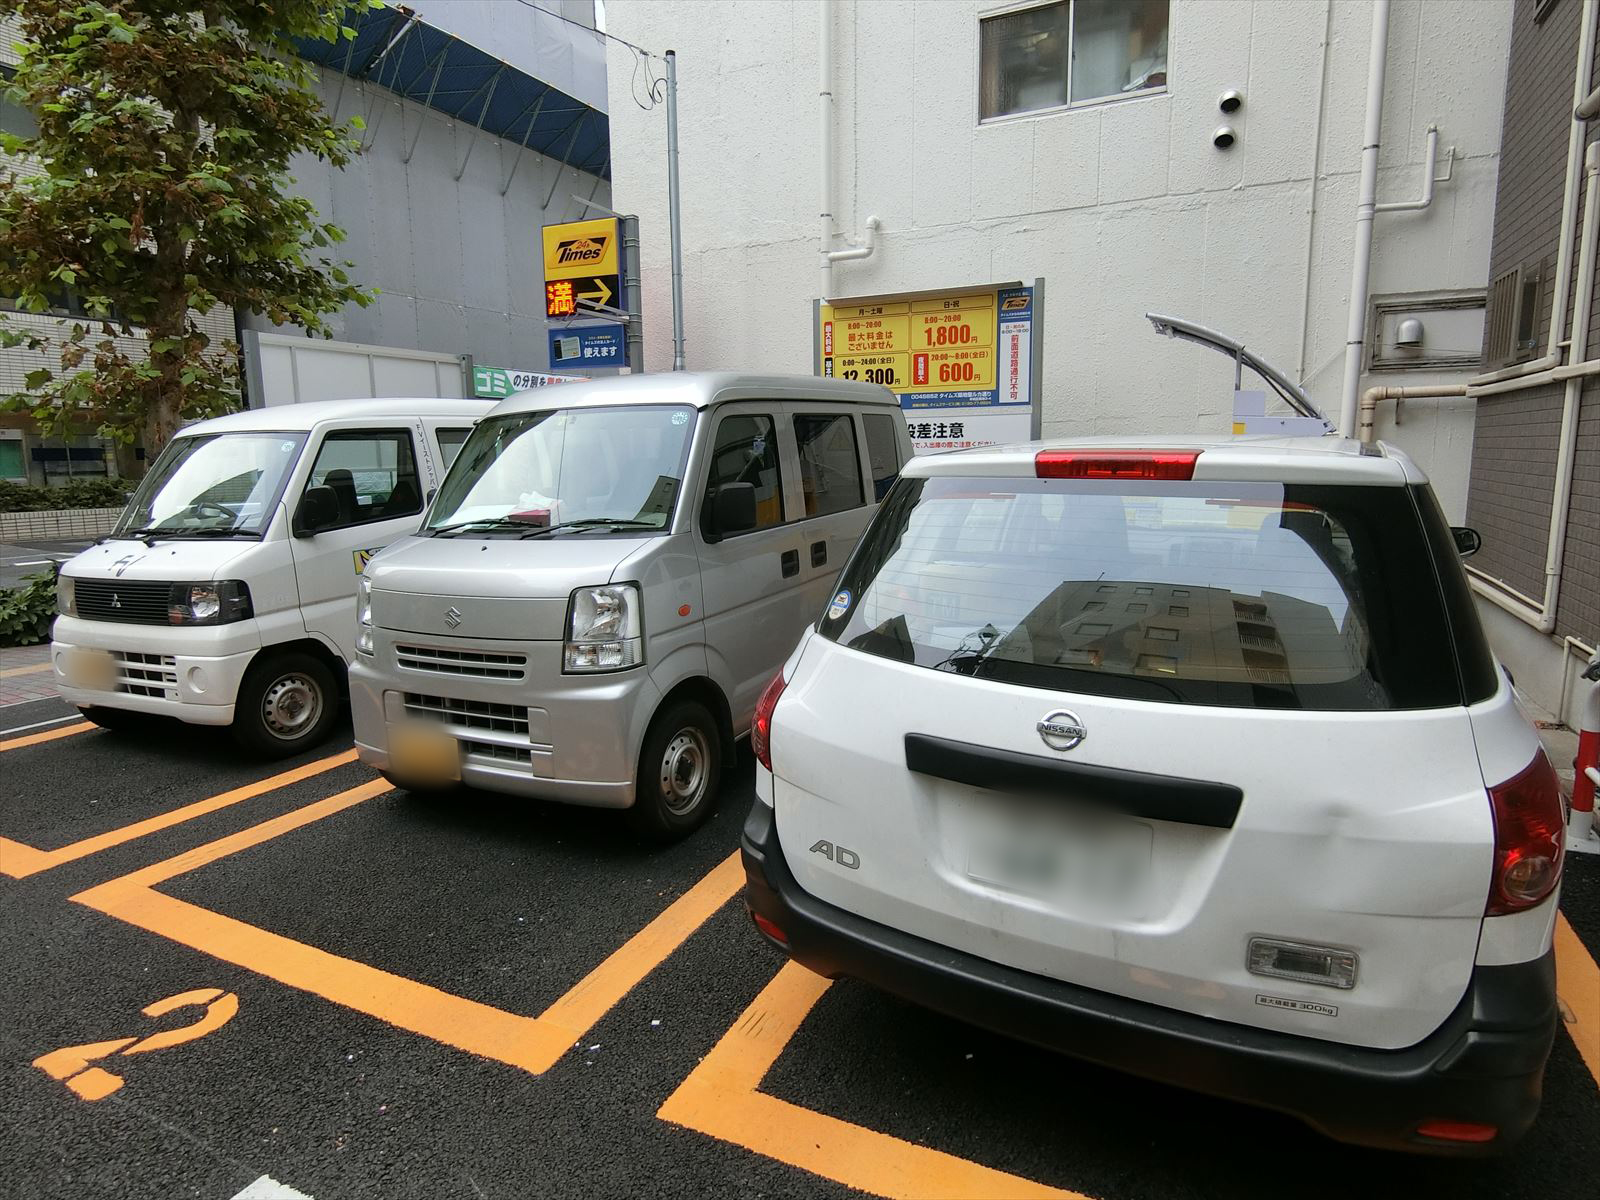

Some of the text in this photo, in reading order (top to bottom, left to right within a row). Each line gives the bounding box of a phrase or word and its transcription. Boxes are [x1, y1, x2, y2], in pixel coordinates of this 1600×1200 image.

[558, 248, 602, 264] Times
[547, 281, 575, 315] 満
[848, 330, 894, 342] 最大料金は
[584, 346, 617, 358] 使えます
[848, 340, 894, 351] ございません
[939, 362, 981, 383] 600円
[1010, 334, 1019, 400] 前面道路通行不可
[476, 371, 507, 394] ゴミ
[1041, 724, 1080, 736] NISSAN
[809, 840, 861, 870] AD
[1299, 1003, 1334, 1015] 300kg
